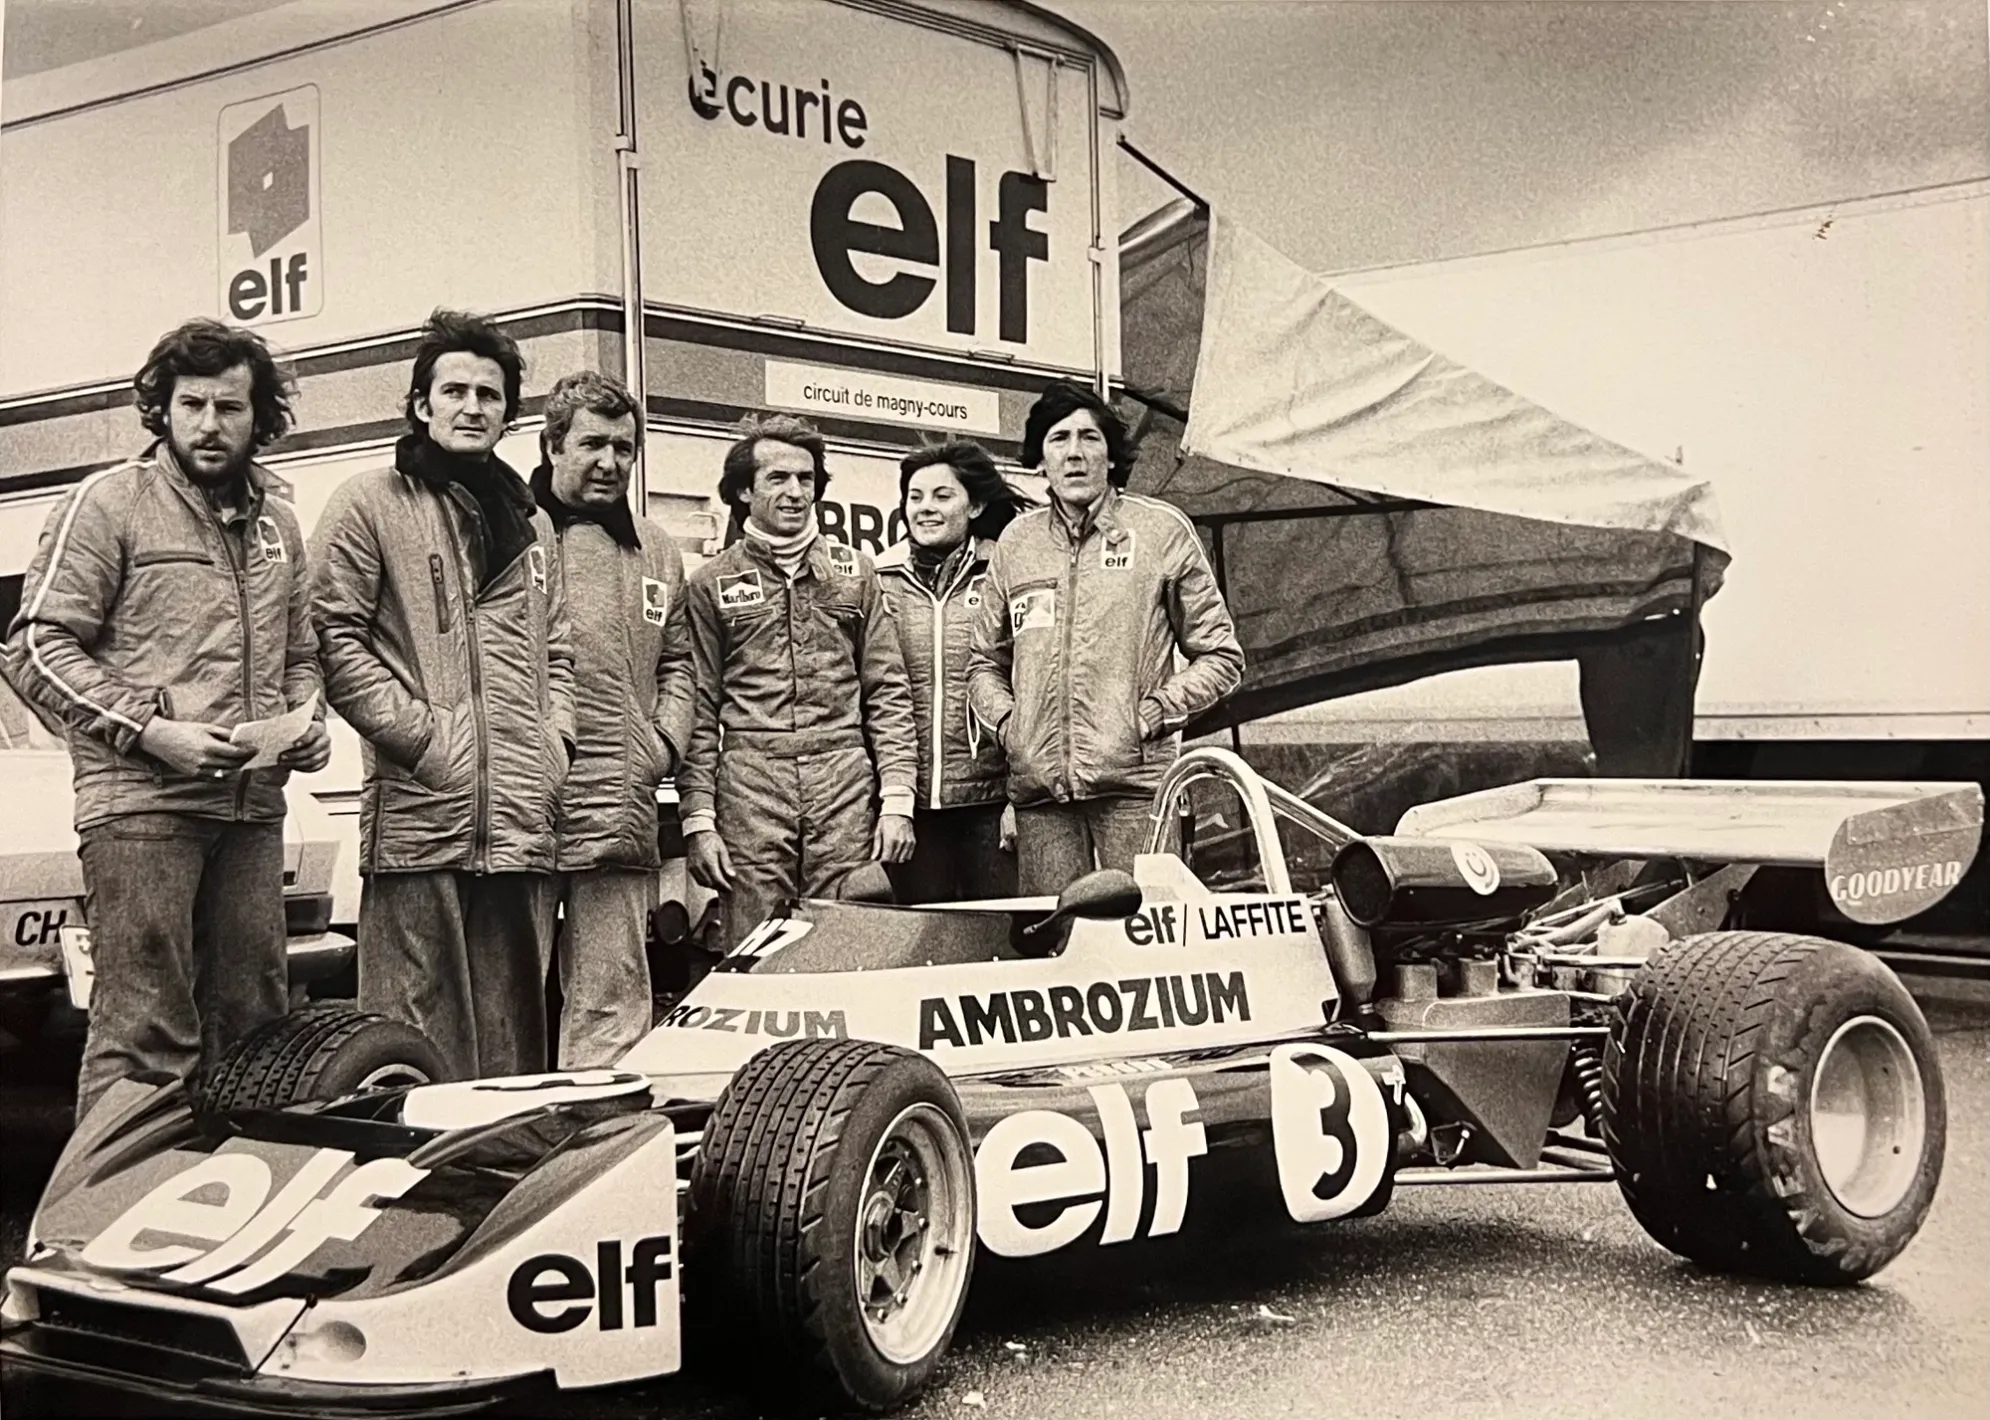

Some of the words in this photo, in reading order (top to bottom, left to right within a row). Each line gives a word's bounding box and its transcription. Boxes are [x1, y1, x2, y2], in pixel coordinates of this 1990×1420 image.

[228, 251, 307, 320] elf
[810, 154, 1049, 344] elf
[803, 376, 850, 405] circuit
[854, 389, 872, 407] de
[877, 394, 968, 420] magny-cours
[1104, 556, 1128, 567] elf
[645, 608, 663, 622] elf
[1830, 860, 1962, 902] GOODYEAR
[1198, 899, 1307, 940] LAFFITE
[918, 970, 1251, 1050] AMBROZIUM
[1290, 1052, 1358, 1201] 3
[973, 1077, 1208, 1258] elf
[81, 1147, 432, 1295] elf
[507, 1235, 672, 1334] elf
